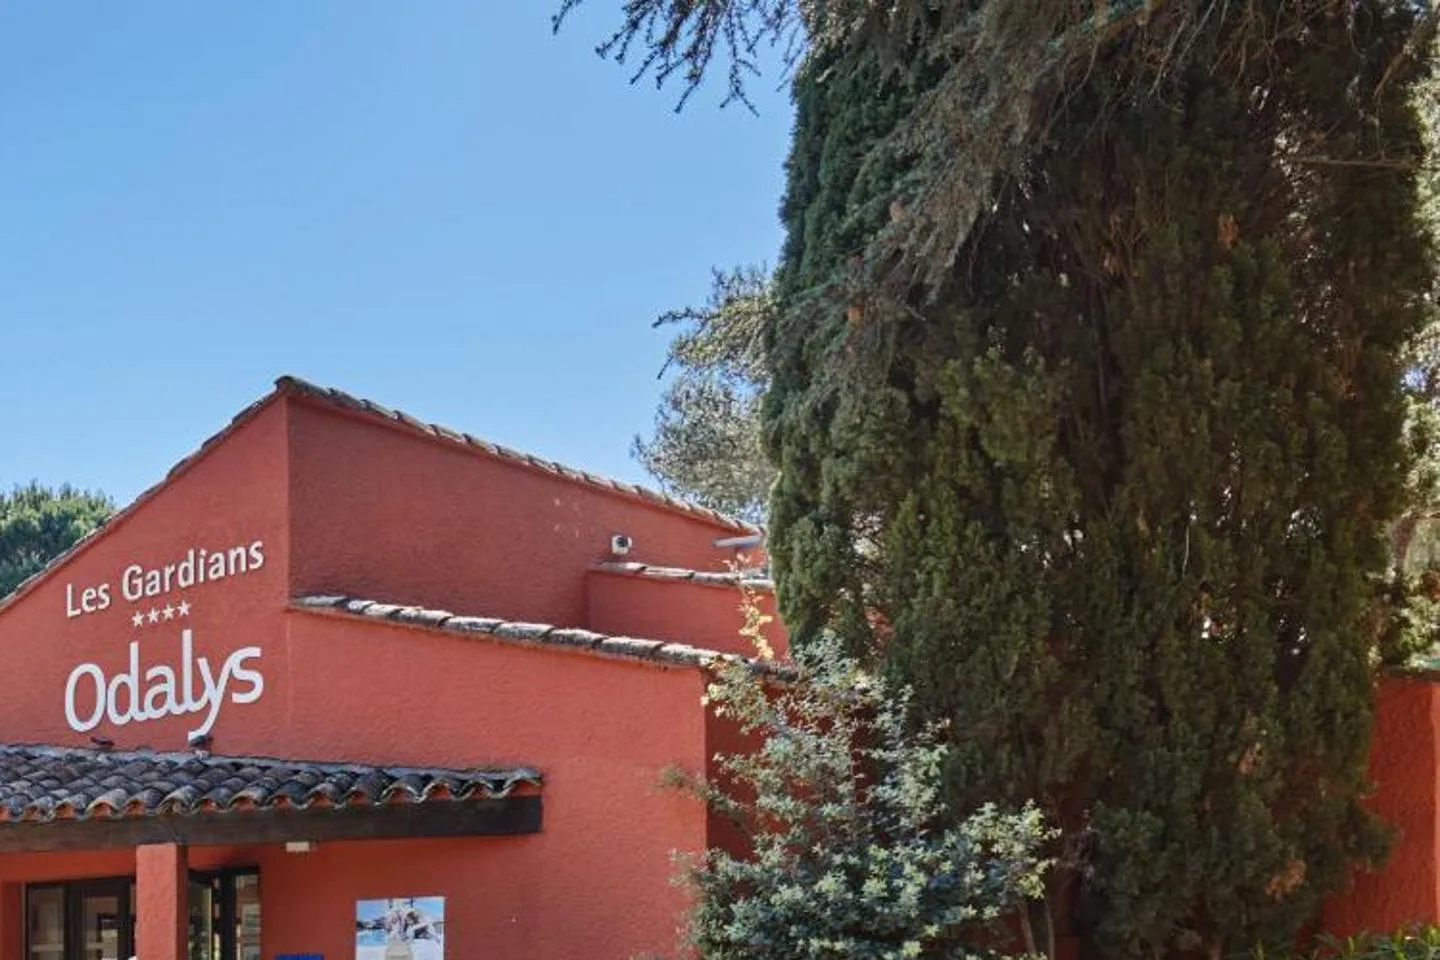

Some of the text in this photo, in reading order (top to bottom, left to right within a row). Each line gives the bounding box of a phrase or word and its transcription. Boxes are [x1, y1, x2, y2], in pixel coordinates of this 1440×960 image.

[66, 540, 265, 618] Les Gardians
[64, 629, 265, 742] Odalys
